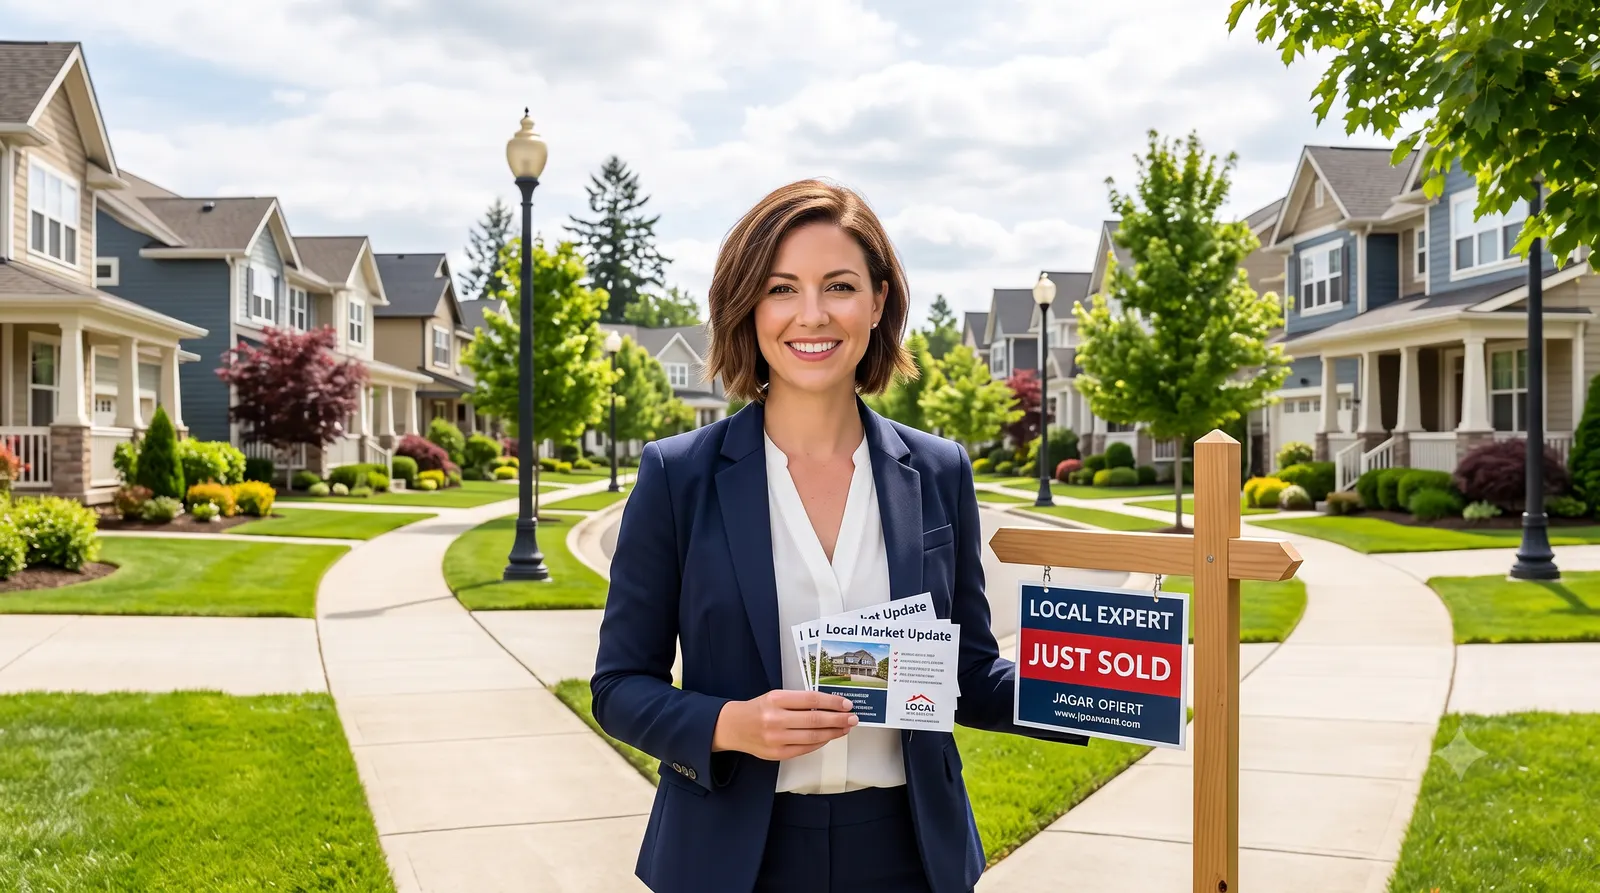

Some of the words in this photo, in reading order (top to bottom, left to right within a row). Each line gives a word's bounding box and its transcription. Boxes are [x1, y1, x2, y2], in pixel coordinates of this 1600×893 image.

[883, 603, 927, 620] Update
[1030, 599, 1092, 622] LOCAL
[1097, 605, 1174, 630] EXPERT
[826, 623, 858, 636] Local
[861, 626, 905, 639] Market
[908, 629, 952, 642] Update
[1029, 643, 1092, 672] JUST
[1098, 650, 1171, 681] SOLD
[905, 703, 935, 712] LOCAL
[1053, 692, 1094, 709] JAGAR
